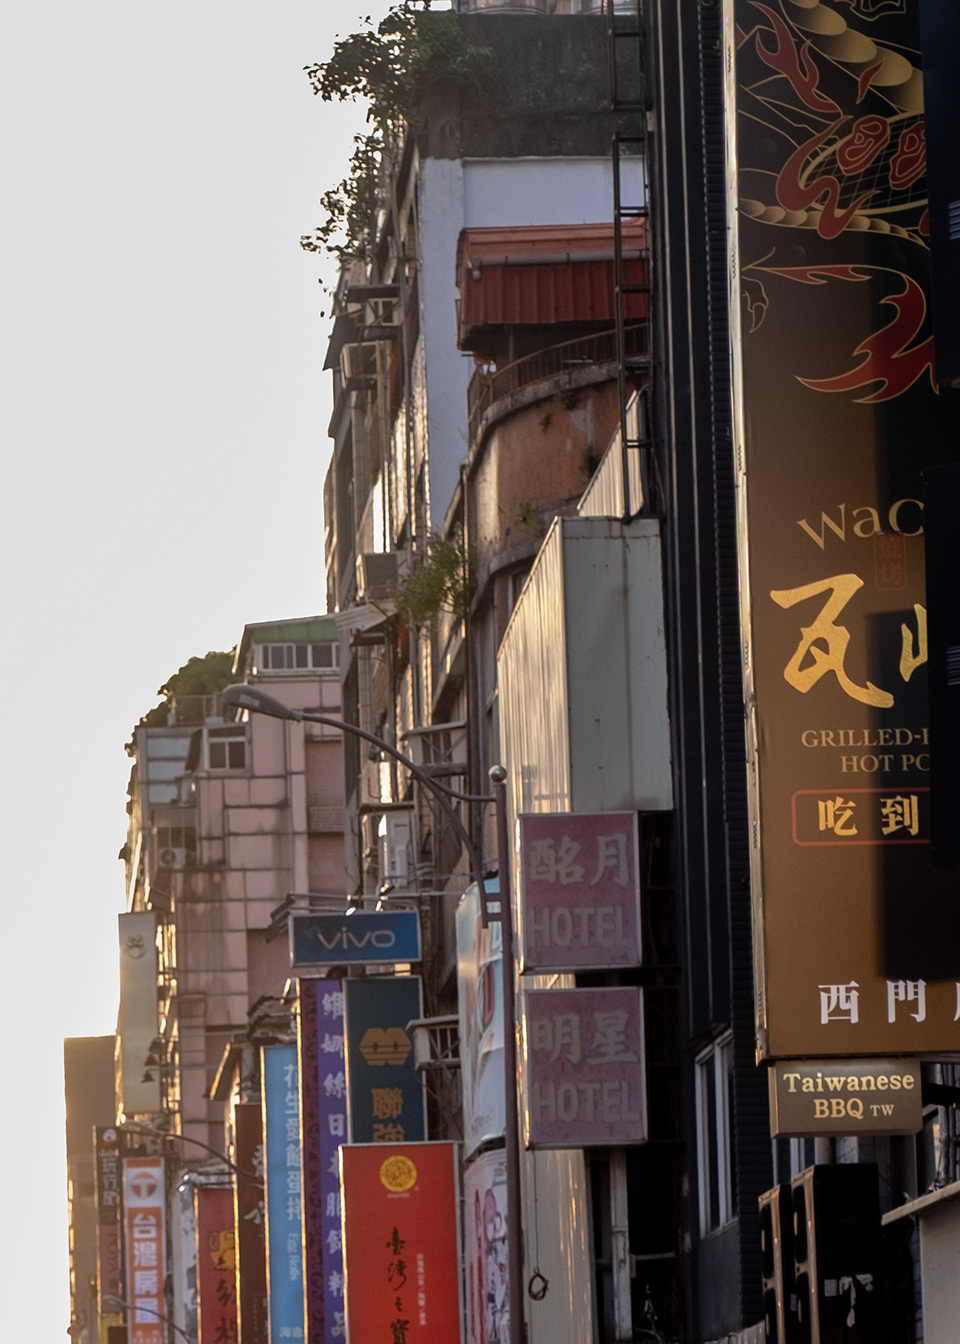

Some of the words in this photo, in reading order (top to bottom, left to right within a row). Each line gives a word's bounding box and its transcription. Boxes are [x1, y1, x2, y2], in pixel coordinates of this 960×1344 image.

[840, 754, 893, 773] HOT
[817, 795, 920, 837] 吃到
[318, 927, 396, 950] vivo
[527, 905, 631, 948] HOTEL
[817, 978, 960, 1025] 西門
[531, 1009, 639, 1065] 明星
[538, 1080, 640, 1123] HOTEL
[783, 1072, 915, 1093] Taiwanese
[813, 1098, 864, 1120] BBQ
[869, 1104, 895, 1117] TW
